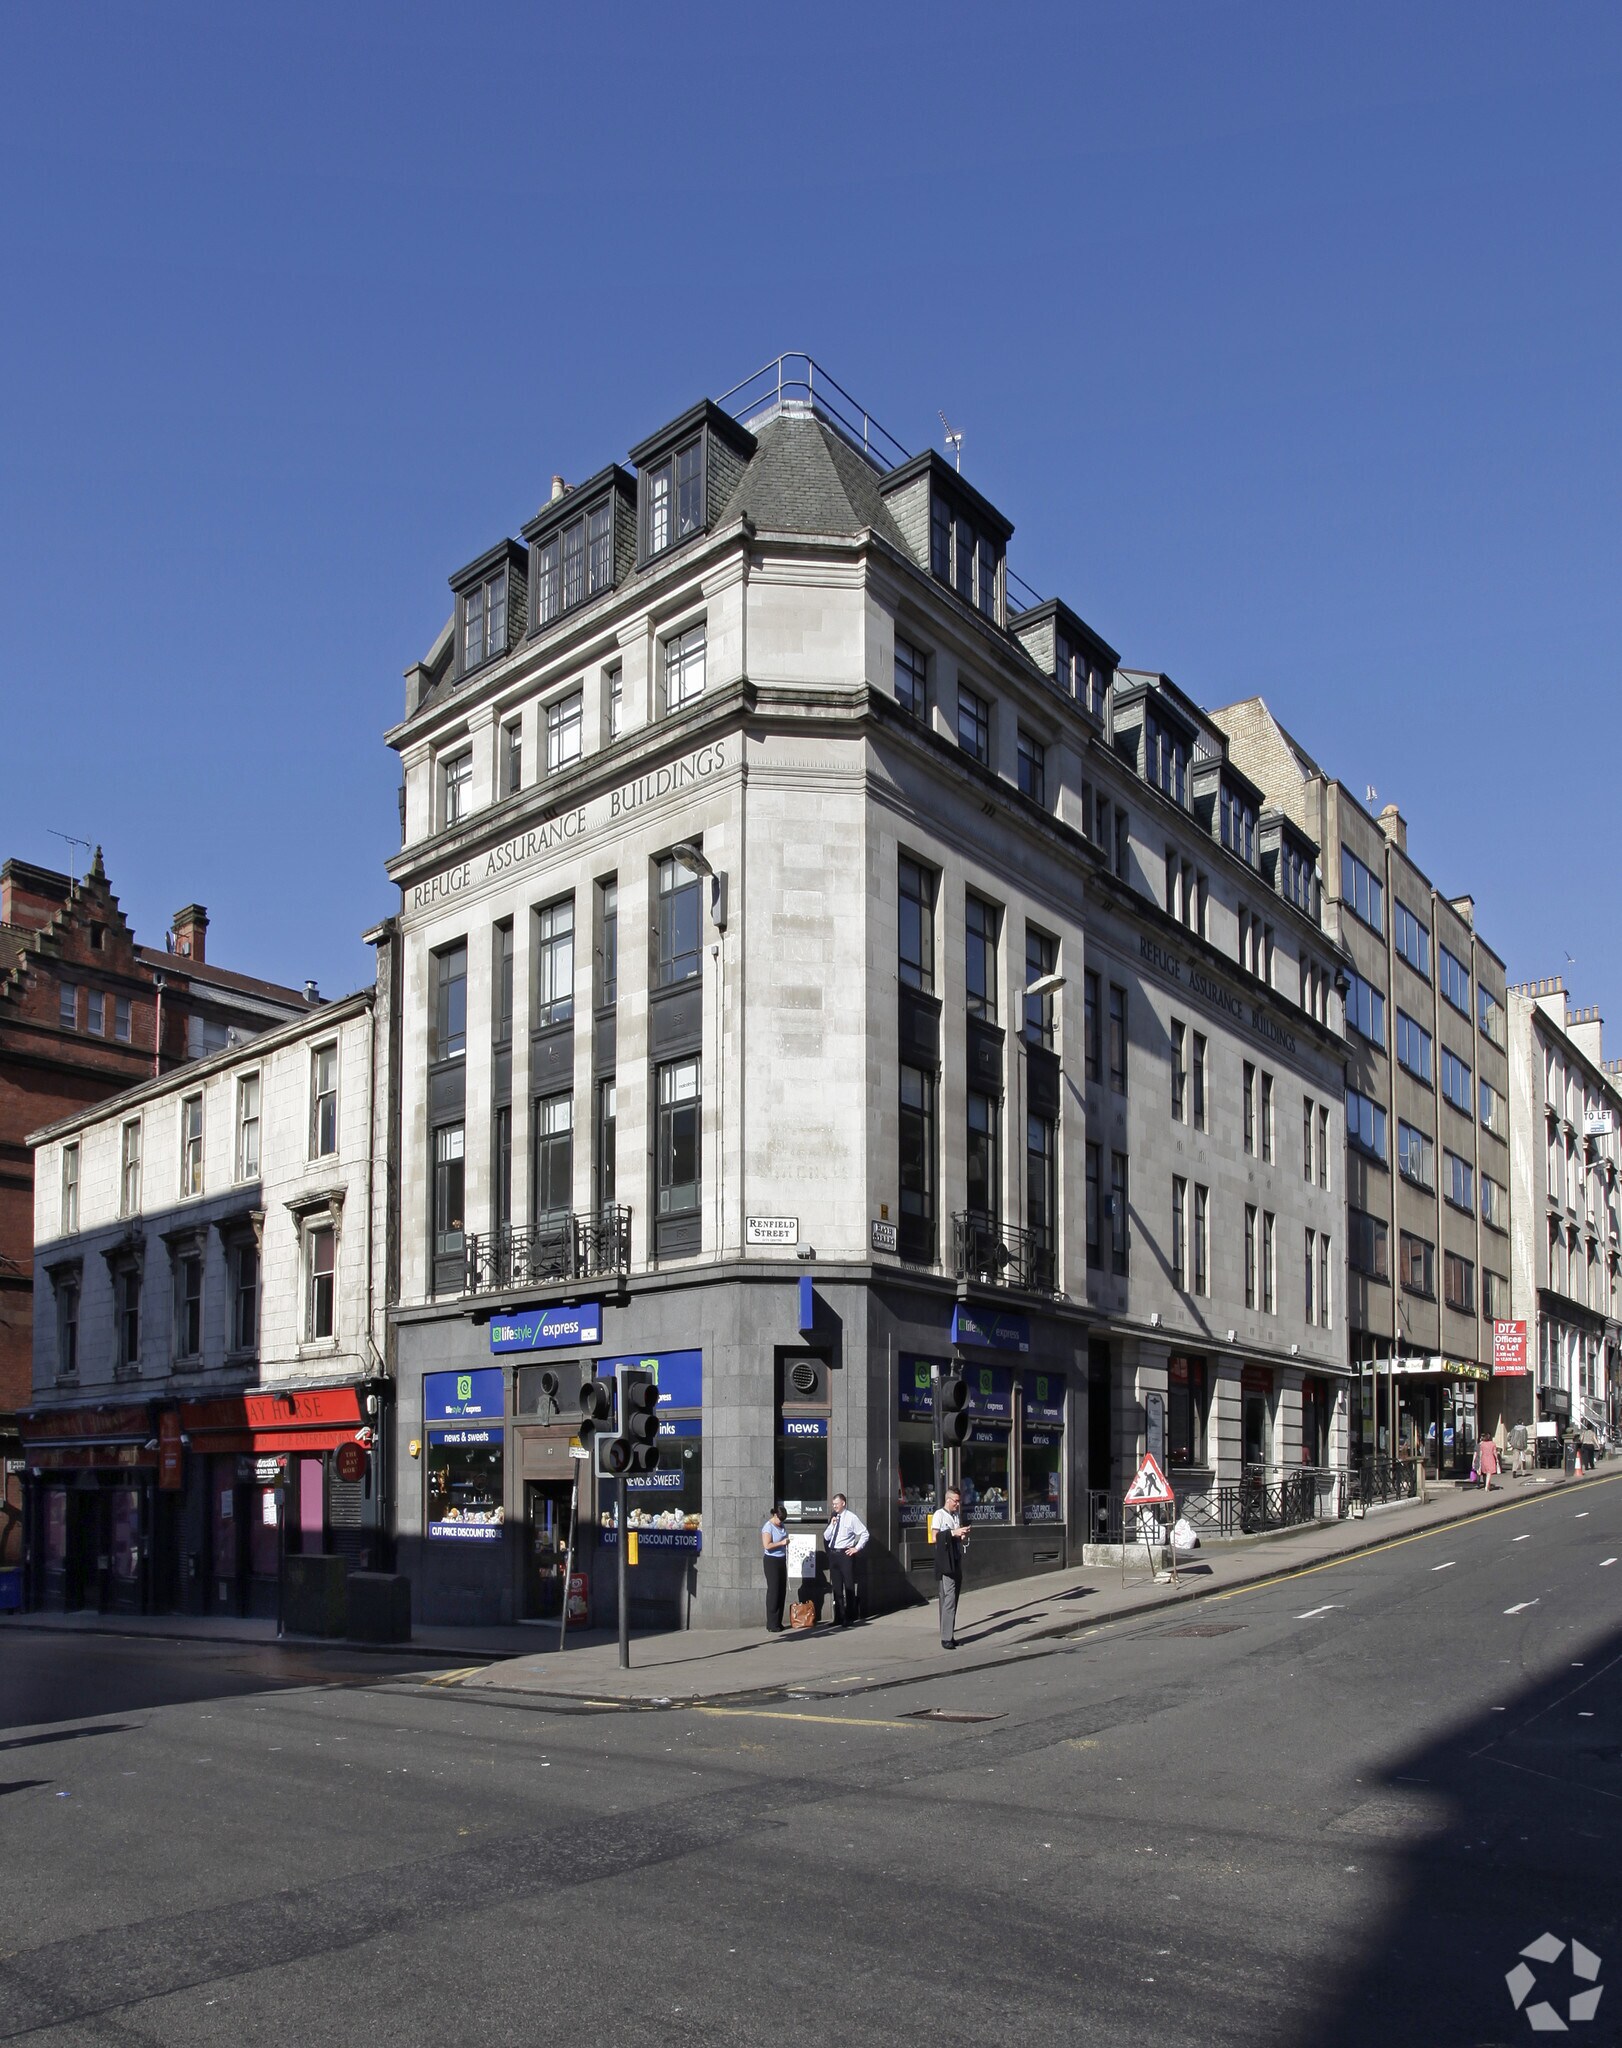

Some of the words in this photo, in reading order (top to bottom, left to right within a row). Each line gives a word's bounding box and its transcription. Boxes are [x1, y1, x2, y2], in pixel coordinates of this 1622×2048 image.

[414, 863, 471, 909] REFUGE
[485, 807, 587, 876] ASSURANCE
[610, 741, 726, 818] BUILDINGS
[1139, 936, 1180, 980] REFUGE
[1189, 971, 1243, 1020] ASSURANCE
[1252, 1011, 1297, 1054] BUILDINGS
[1584, 1111, 1595, 1121] TO
[1597, 1111, 1612, 1120] LET
[749, 1219, 796, 1229] RENFIELD
[754, 1228, 790, 1238] STREET
[501, 1325, 532, 1342] lifestyle
[543, 1321, 579, 1339] express
[1498, 1323, 1517, 1334] DTZ
[995, 1328, 1020, 1340] express
[1495, 1335, 1522, 1343] Offices
[1495, 1343, 1505, 1351] To
[1506, 1343, 1519, 1351] Let
[658, 1392, 671, 1403] press
[465, 1404, 482, 1414] express
[987, 1402, 1004, 1412] express
[1043, 1408, 1058, 1418] express
[659, 1422, 676, 1435] inks
[787, 1423, 820, 1433] news
[444, 1433, 461, 1443] news
[462, 1431, 468, 1441] &
[468, 1431, 490, 1442] sweets
[976, 1431, 993, 1442] news
[1033, 1434, 1050, 1445] drinks
[646, 1477, 653, 1486] &
[653, 1474, 682, 1486] SWEETS
[911, 1505, 921, 1515] CUT
[921, 1506, 934, 1515] PRICE
[974, 1504, 984, 1514] CUT
[984, 1505, 996, 1514] PRICE
[1031, 1504, 1041, 1513] CUT
[1041, 1504, 1052, 1513] PRICE
[967, 1511, 990, 1521] DISCOUNT
[990, 1511, 1003, 1521] STORE
[1025, 1511, 1045, 1520] DISCOUNT
[1045, 1511, 1057, 1520] STORE
[432, 1526, 443, 1536] CUT
[443, 1527, 457, 1537] PRICE
[457, 1528, 485, 1539] DISCOUNT
[485, 1529, 503, 1540] STORE
[604, 1533, 618, 1543] CUT
[638, 1534, 673, 1546] DISCOUNT
[674, 1535, 698, 1546] STORE
